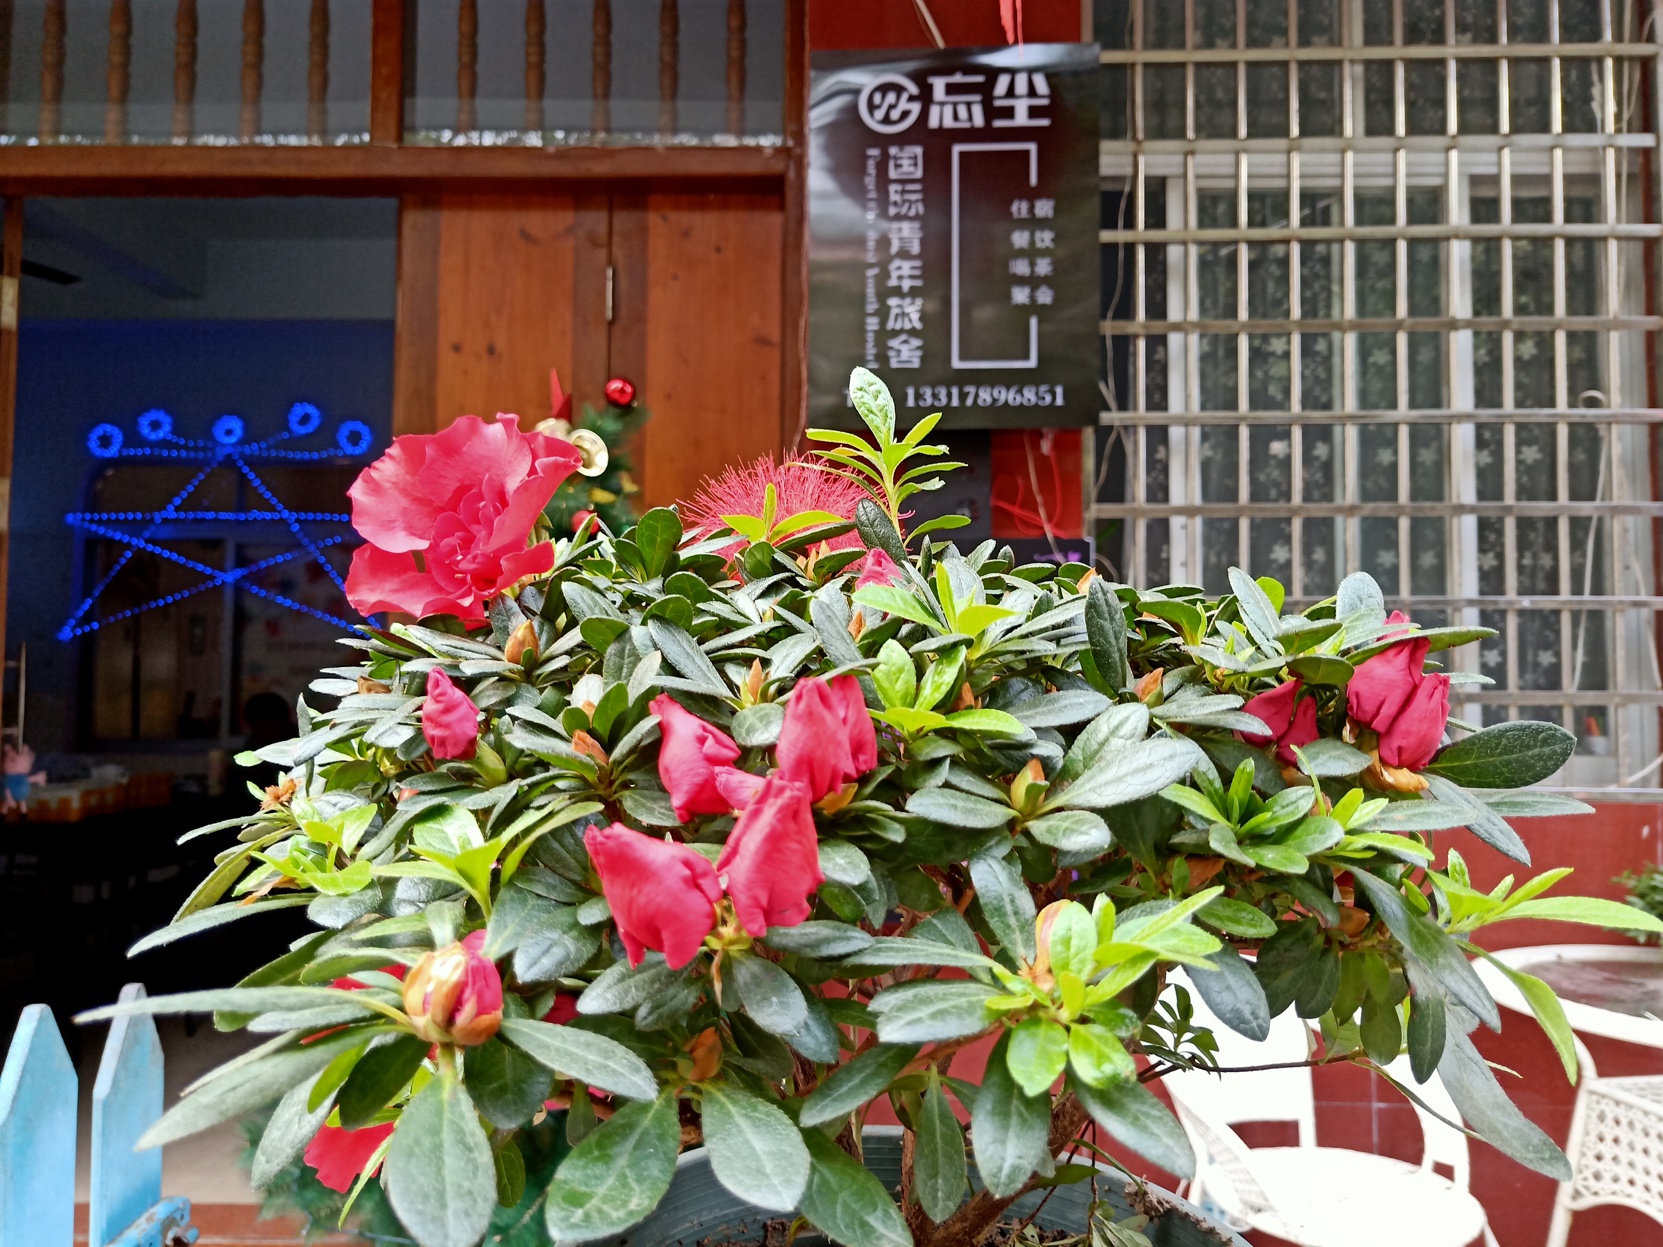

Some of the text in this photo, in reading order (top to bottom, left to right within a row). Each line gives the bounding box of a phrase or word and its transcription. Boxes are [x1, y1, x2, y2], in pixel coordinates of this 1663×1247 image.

[927, 72, 1051, 129] 忘尘
[864, 147, 881, 199] Forget
[1010, 199, 1056, 219] 住宿
[886, 145, 924, 369] 国际青年旅舍
[864, 266, 881, 313] Youth
[864, 316, 881, 369] Hostel
[905, 384, 1065, 407] 13317896851
